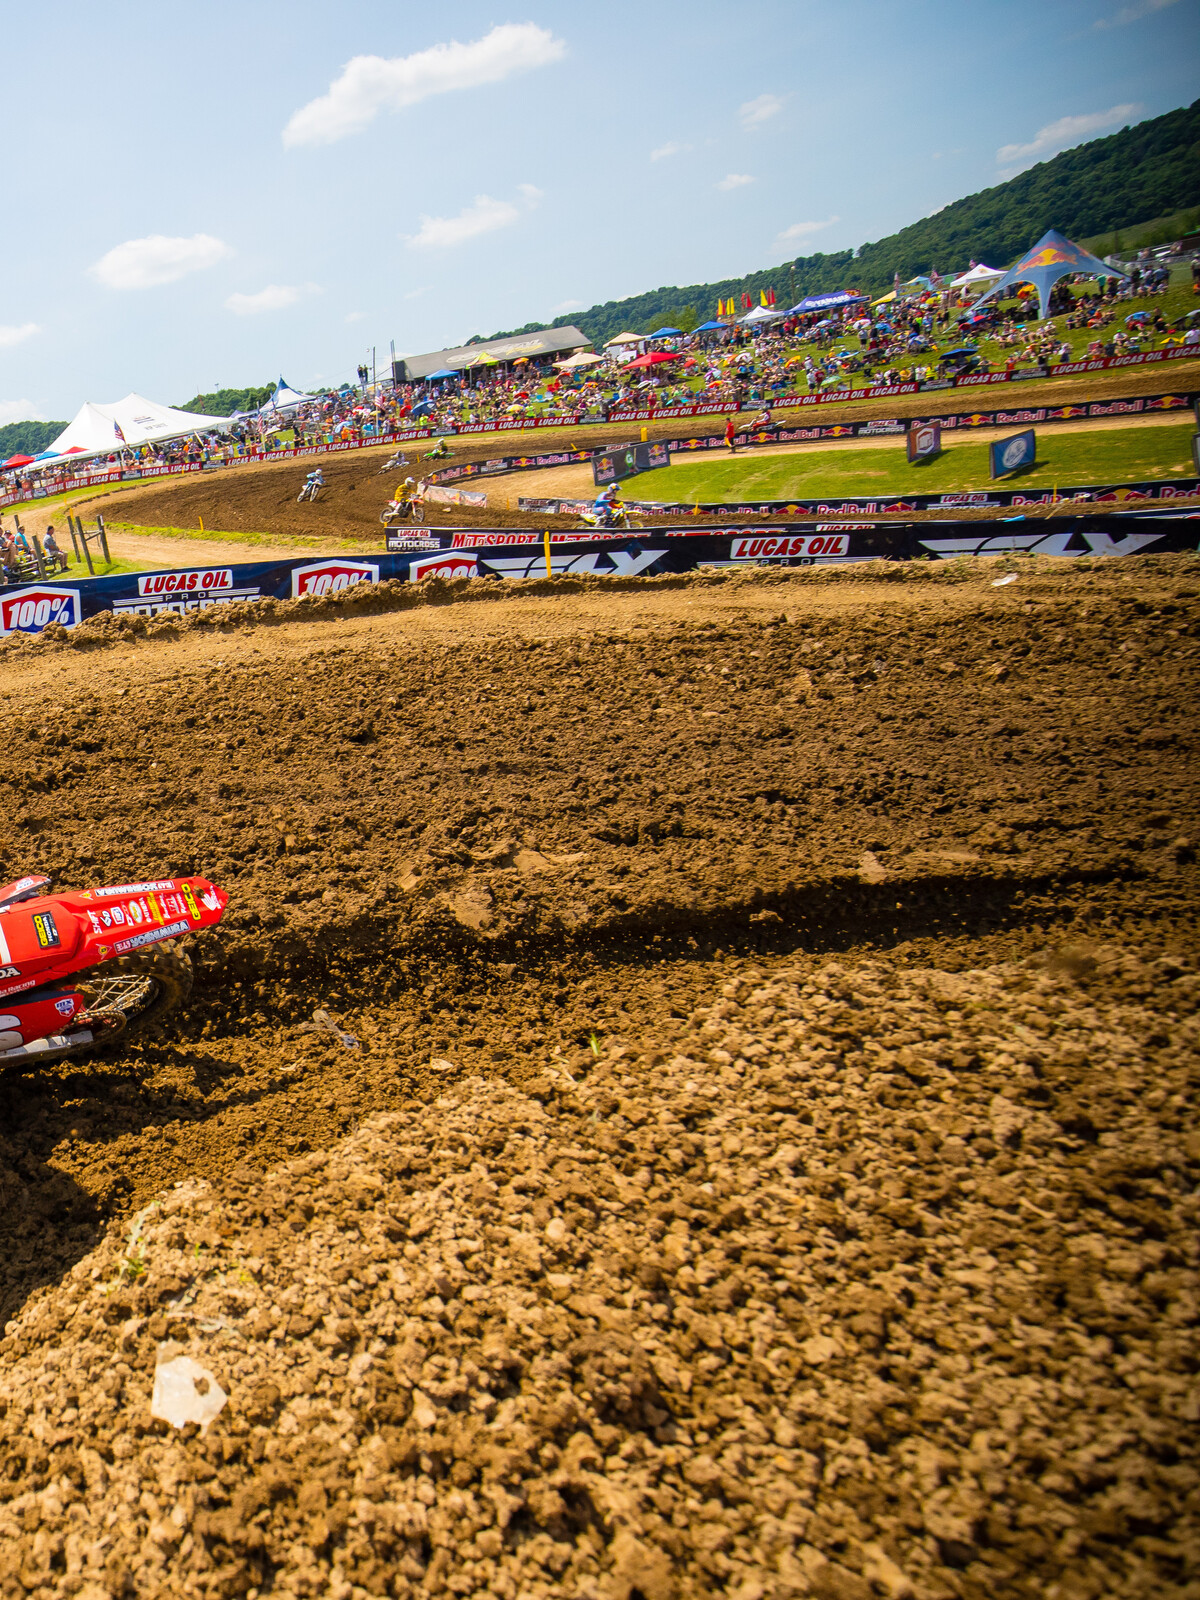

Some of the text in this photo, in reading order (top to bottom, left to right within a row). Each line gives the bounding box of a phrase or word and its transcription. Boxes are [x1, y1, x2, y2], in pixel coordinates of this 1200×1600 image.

[1109, 352, 1163, 367] LUCAS OIL
[1052, 360, 1104, 374] LUCAS OIL
[957, 373, 1007, 385] LUCAS OIL
[820, 389, 865, 402] LUCAS OIL
[869, 384, 915, 397] LUCAS OIL
[773, 395, 817, 407] LUCAS OIL
[653, 407, 693, 418] LUCAS OIL
[696, 403, 738, 414] LUCAS OIL
[538, 418, 562, 426] LUCAS
[564, 416, 576, 424] OIL
[610, 413, 635, 422] LUCAS
[637, 411, 650, 419] OIL
[460, 424, 482, 433] LUCAS
[484, 422, 496, 431] OIL
[498, 419, 536, 430] LUCAS OIL
[396, 431, 416, 441] LUCAS
[417, 430, 429, 438] OIL
[943, 493, 987, 502] LUCAS OIL
[420, 529, 430, 537] OIL
[388, 540, 440, 548] MOTOCROSS
[735, 537, 844, 558] LUCAS OIL
[143, 570, 230, 595] LUCAS OIL
[165, 591, 207, 602] PRO
[8, 597, 70, 629] 100%
[180, 882, 202, 921] GEICO
[87, 910, 103, 934] SHIFT
[33, 915, 49, 947] GEICO
[7, 979, 36, 992] Racing
